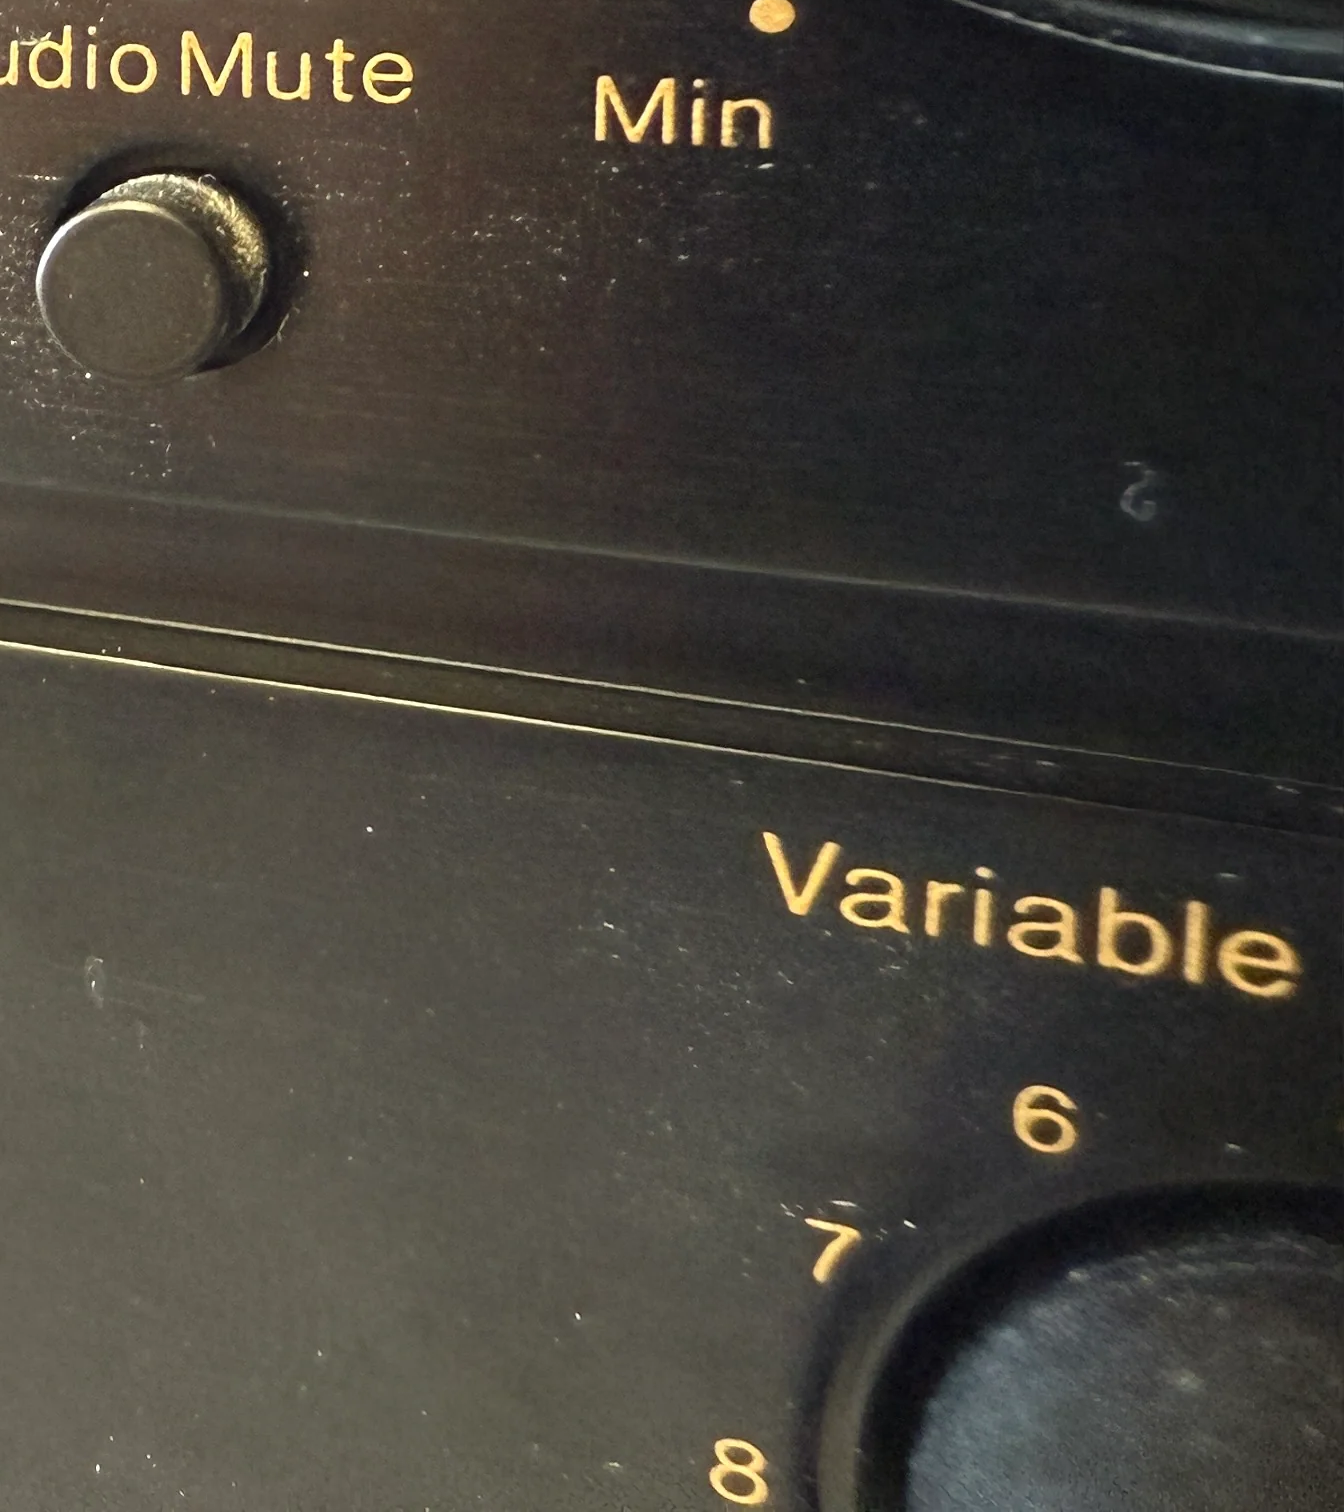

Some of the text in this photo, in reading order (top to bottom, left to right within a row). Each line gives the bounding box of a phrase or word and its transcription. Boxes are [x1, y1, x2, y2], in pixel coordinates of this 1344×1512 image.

[180, 29, 414, 105] Mute
[594, 74, 775, 151] Min
[762, 830, 1303, 999] Variable
[1011, 1083, 1080, 1156] 6
[804, 1216, 863, 1284] 7
[708, 1437, 770, 1506] 8
